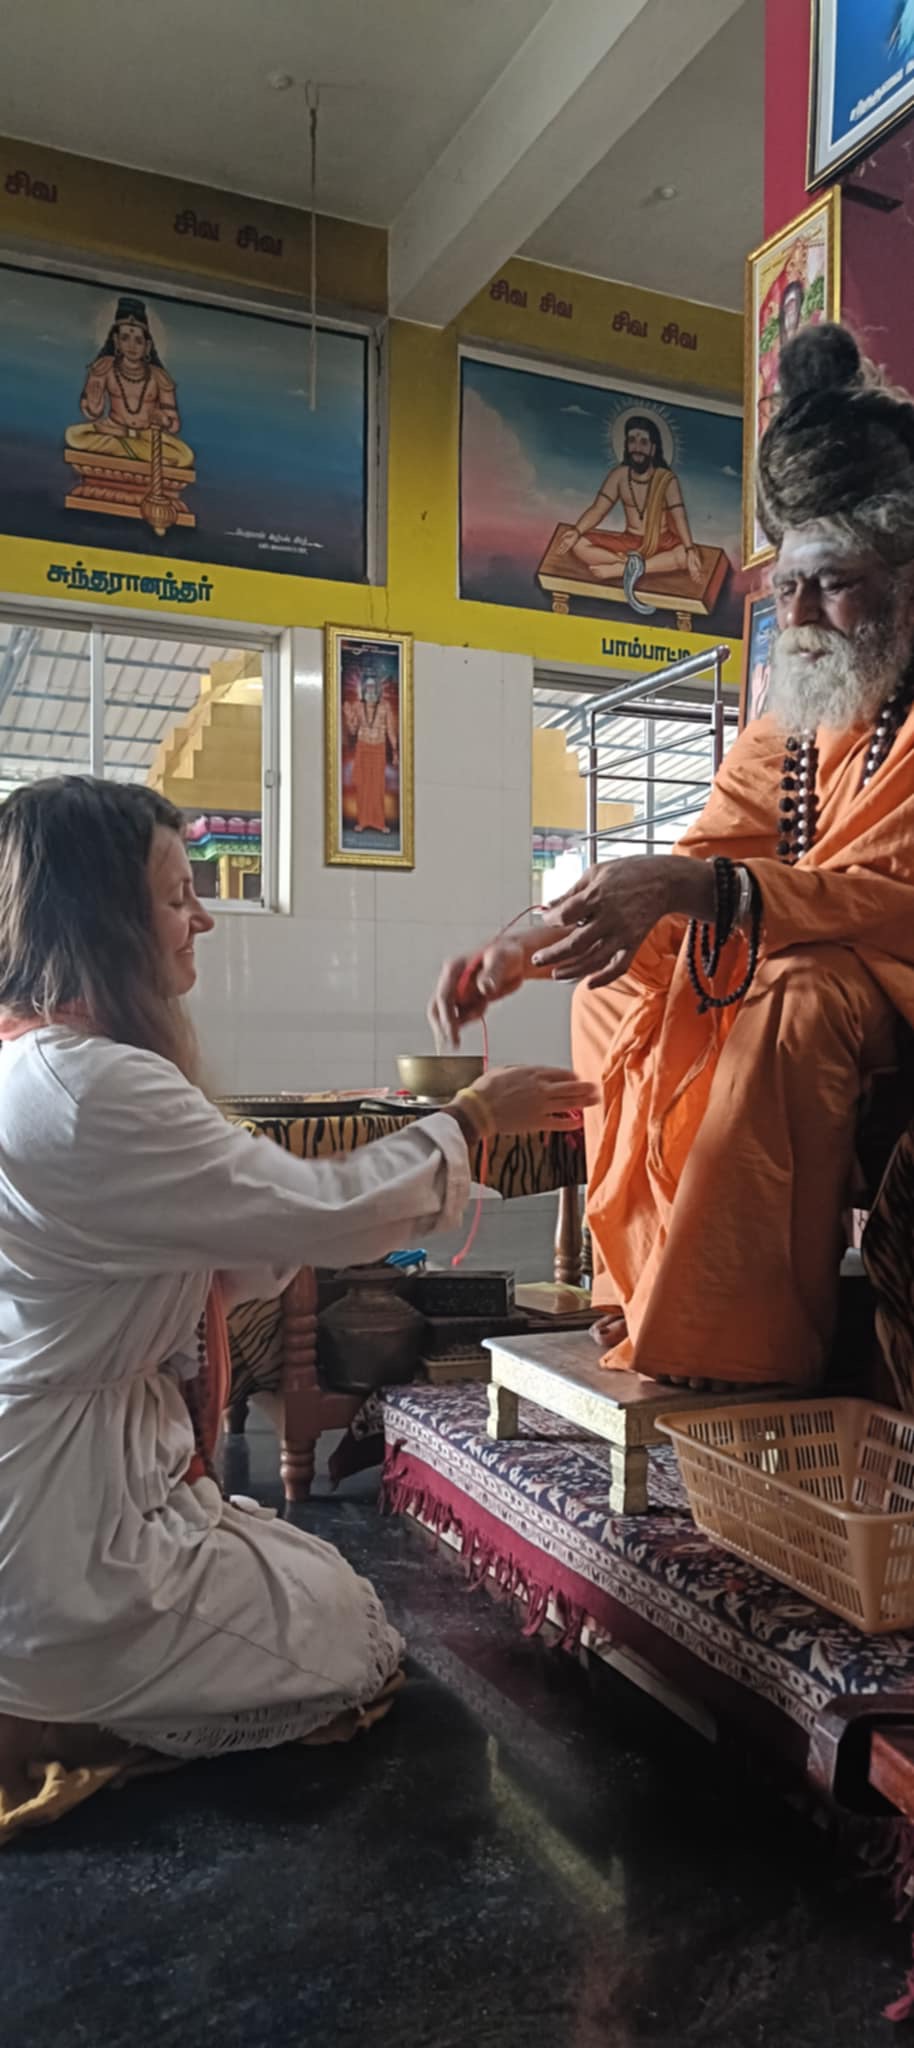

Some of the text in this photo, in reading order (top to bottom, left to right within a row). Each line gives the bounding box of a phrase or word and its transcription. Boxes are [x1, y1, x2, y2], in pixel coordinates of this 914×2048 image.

[4, 170, 283, 256] சிவ சிவ சிவ
[490, 279, 697, 350] சிவ சிவ சிவ சிவ
[47, 560, 213, 603] சுந்தரானந்தர்
